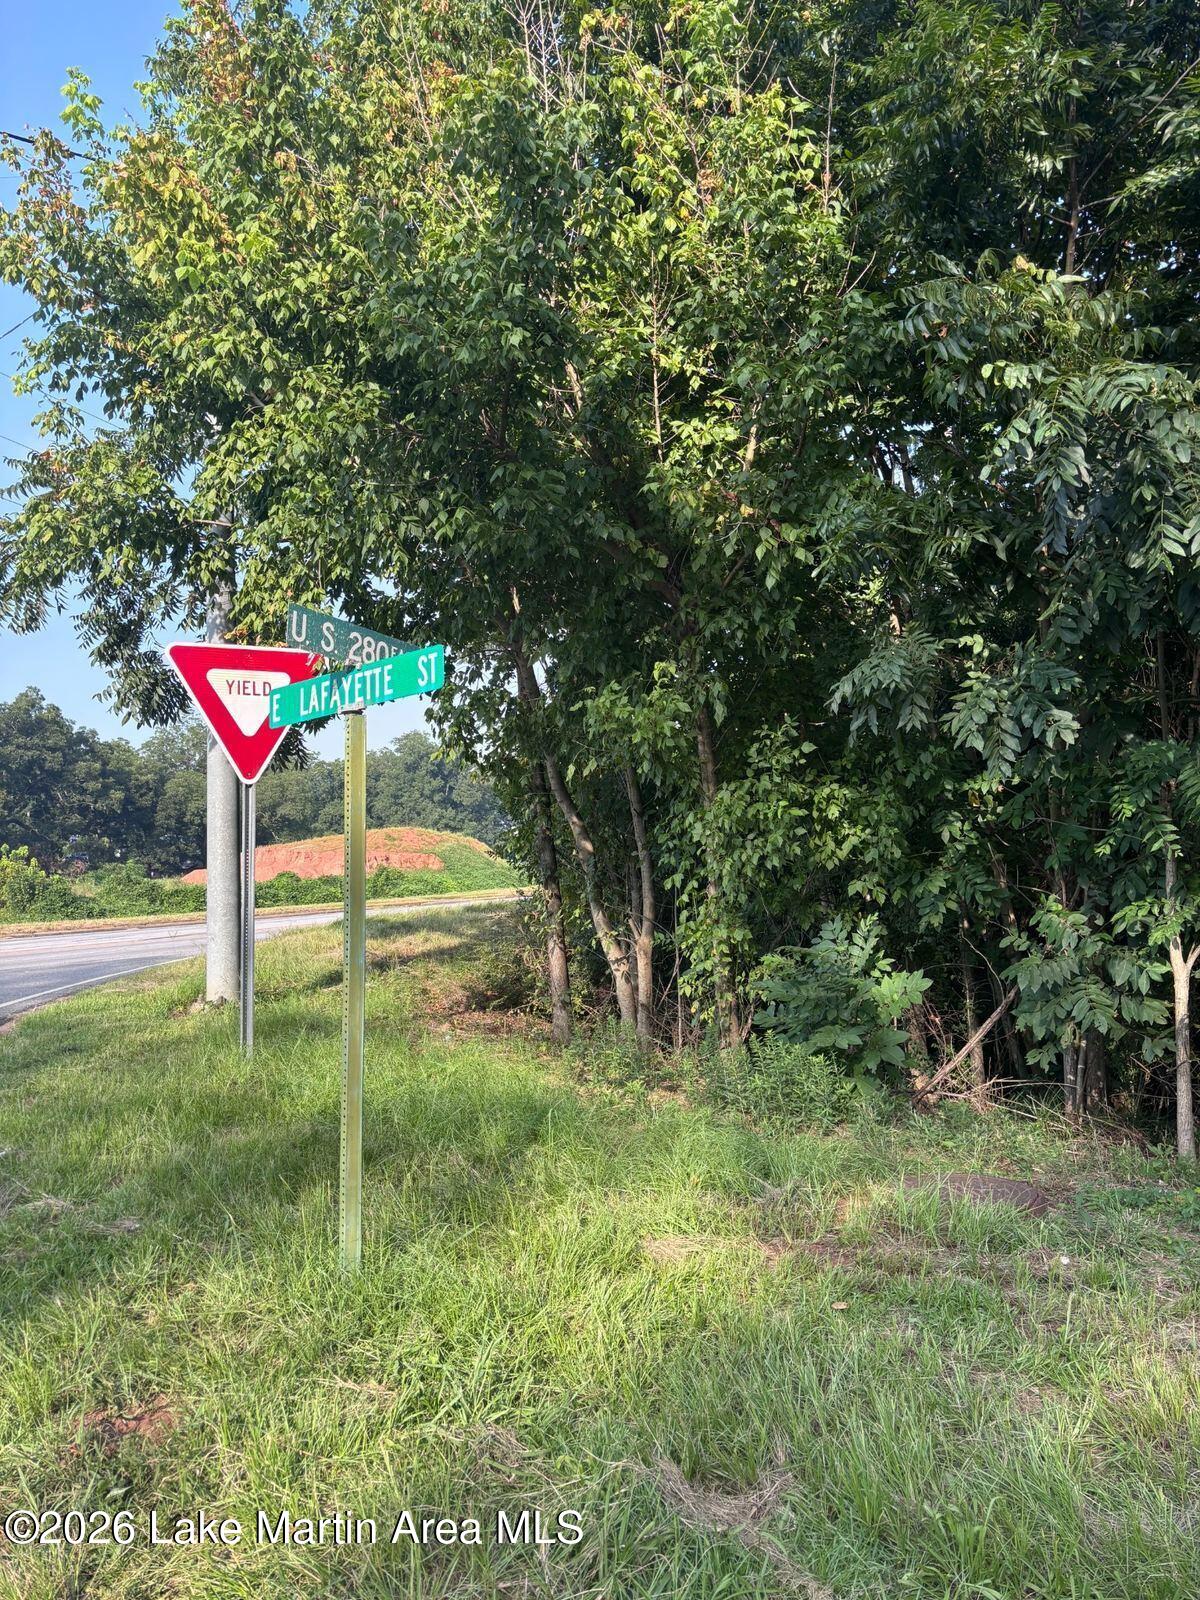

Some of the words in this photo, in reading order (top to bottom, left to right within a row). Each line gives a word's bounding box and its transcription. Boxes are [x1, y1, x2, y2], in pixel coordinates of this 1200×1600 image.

[348, 631, 389, 664] 280
[225, 679, 272, 697] YIELD
[272, 693, 281, 723] E
[300, 664, 394, 717] LAFAYETTE
[417, 652, 438, 687] ST
